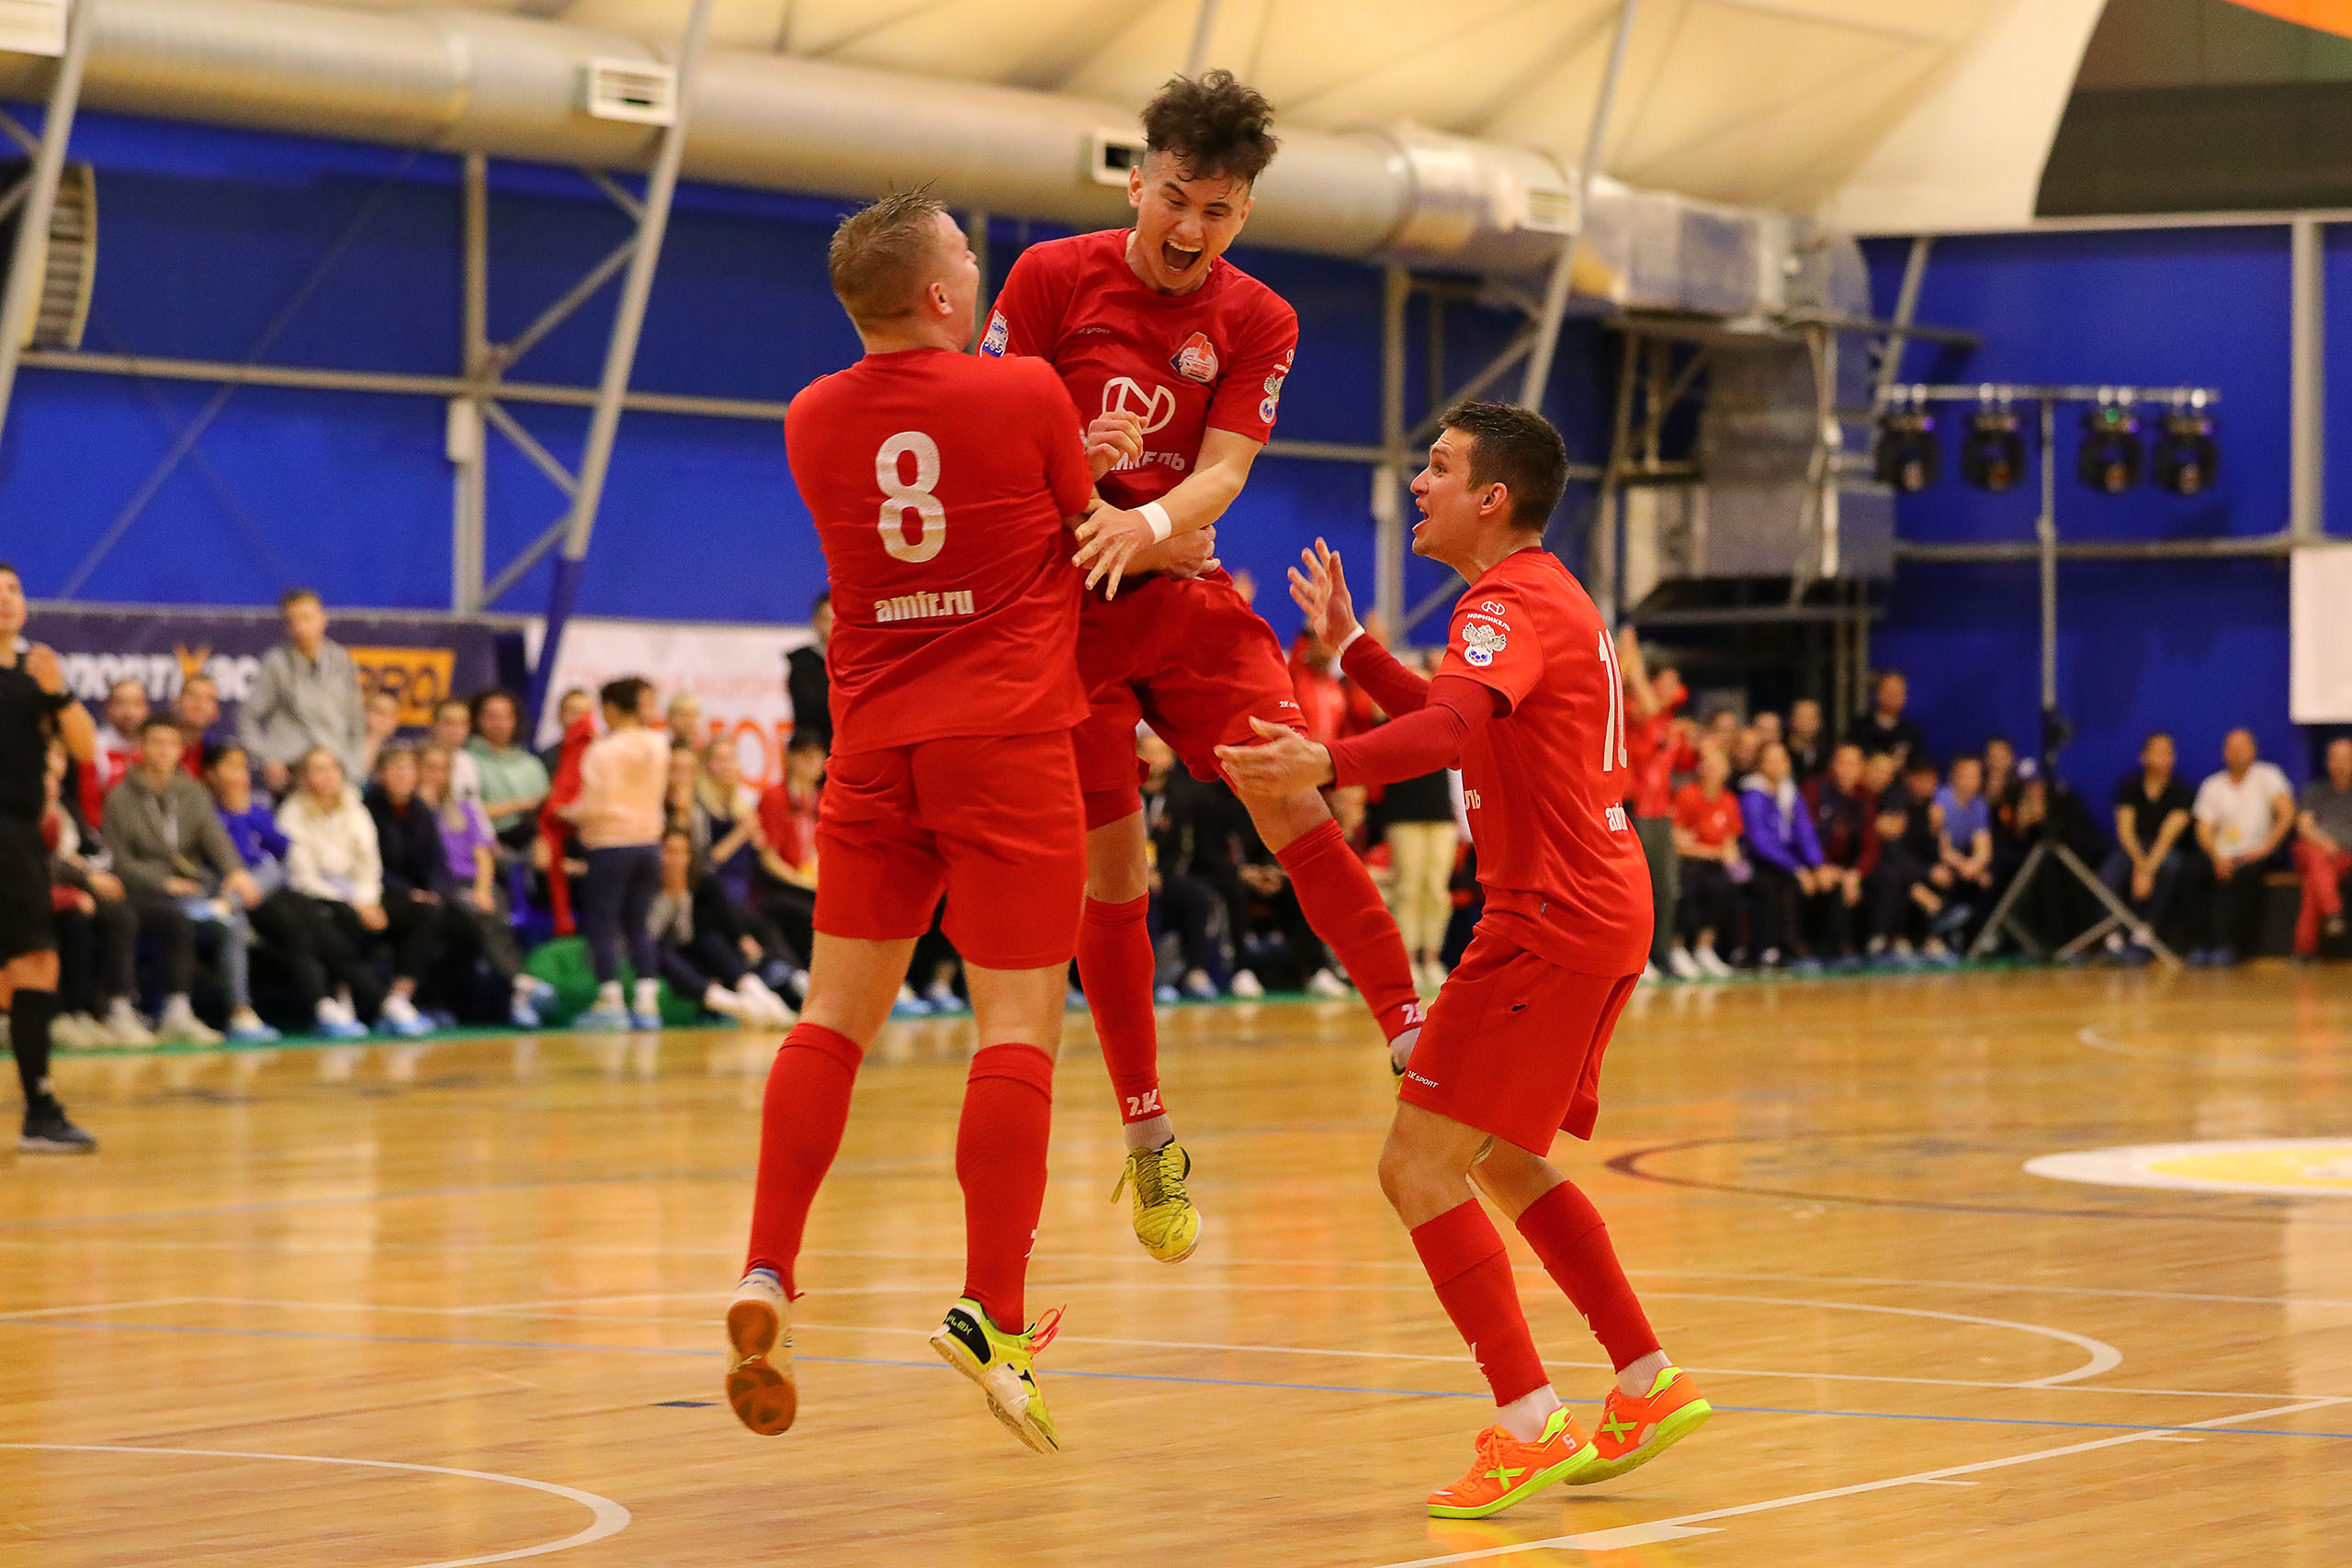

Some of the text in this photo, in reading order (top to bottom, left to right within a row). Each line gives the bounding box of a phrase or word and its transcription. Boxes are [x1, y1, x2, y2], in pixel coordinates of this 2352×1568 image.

[875, 431, 946, 564] 8
[1466, 613, 1511, 632] НОРНИКЕЛЬ
[1415, 1075, 1439, 1089] SPORT
